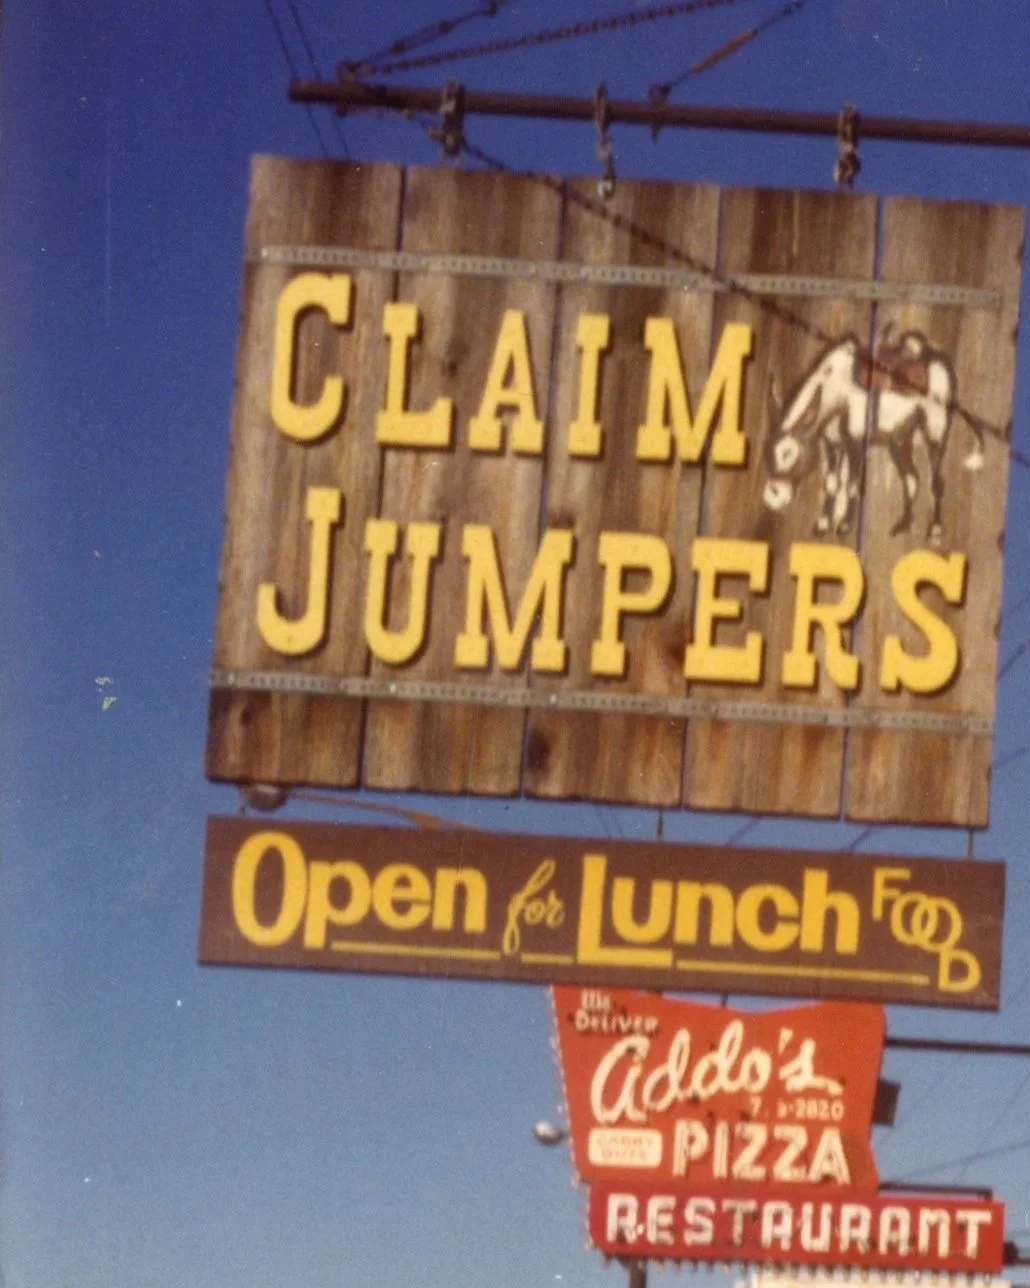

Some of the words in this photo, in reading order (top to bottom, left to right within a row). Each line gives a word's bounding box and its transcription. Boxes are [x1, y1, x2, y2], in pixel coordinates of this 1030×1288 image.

[269, 273, 752, 466] CLAIM
[255, 486, 967, 695] JUMPERS
[231, 831, 489, 949] Open
[502, 857, 566, 956] for
[576, 852, 861, 968] Lunch
[672, 1118, 851, 1185] PIZZA
[606, 1193, 992, 1261] RESTAURANT
